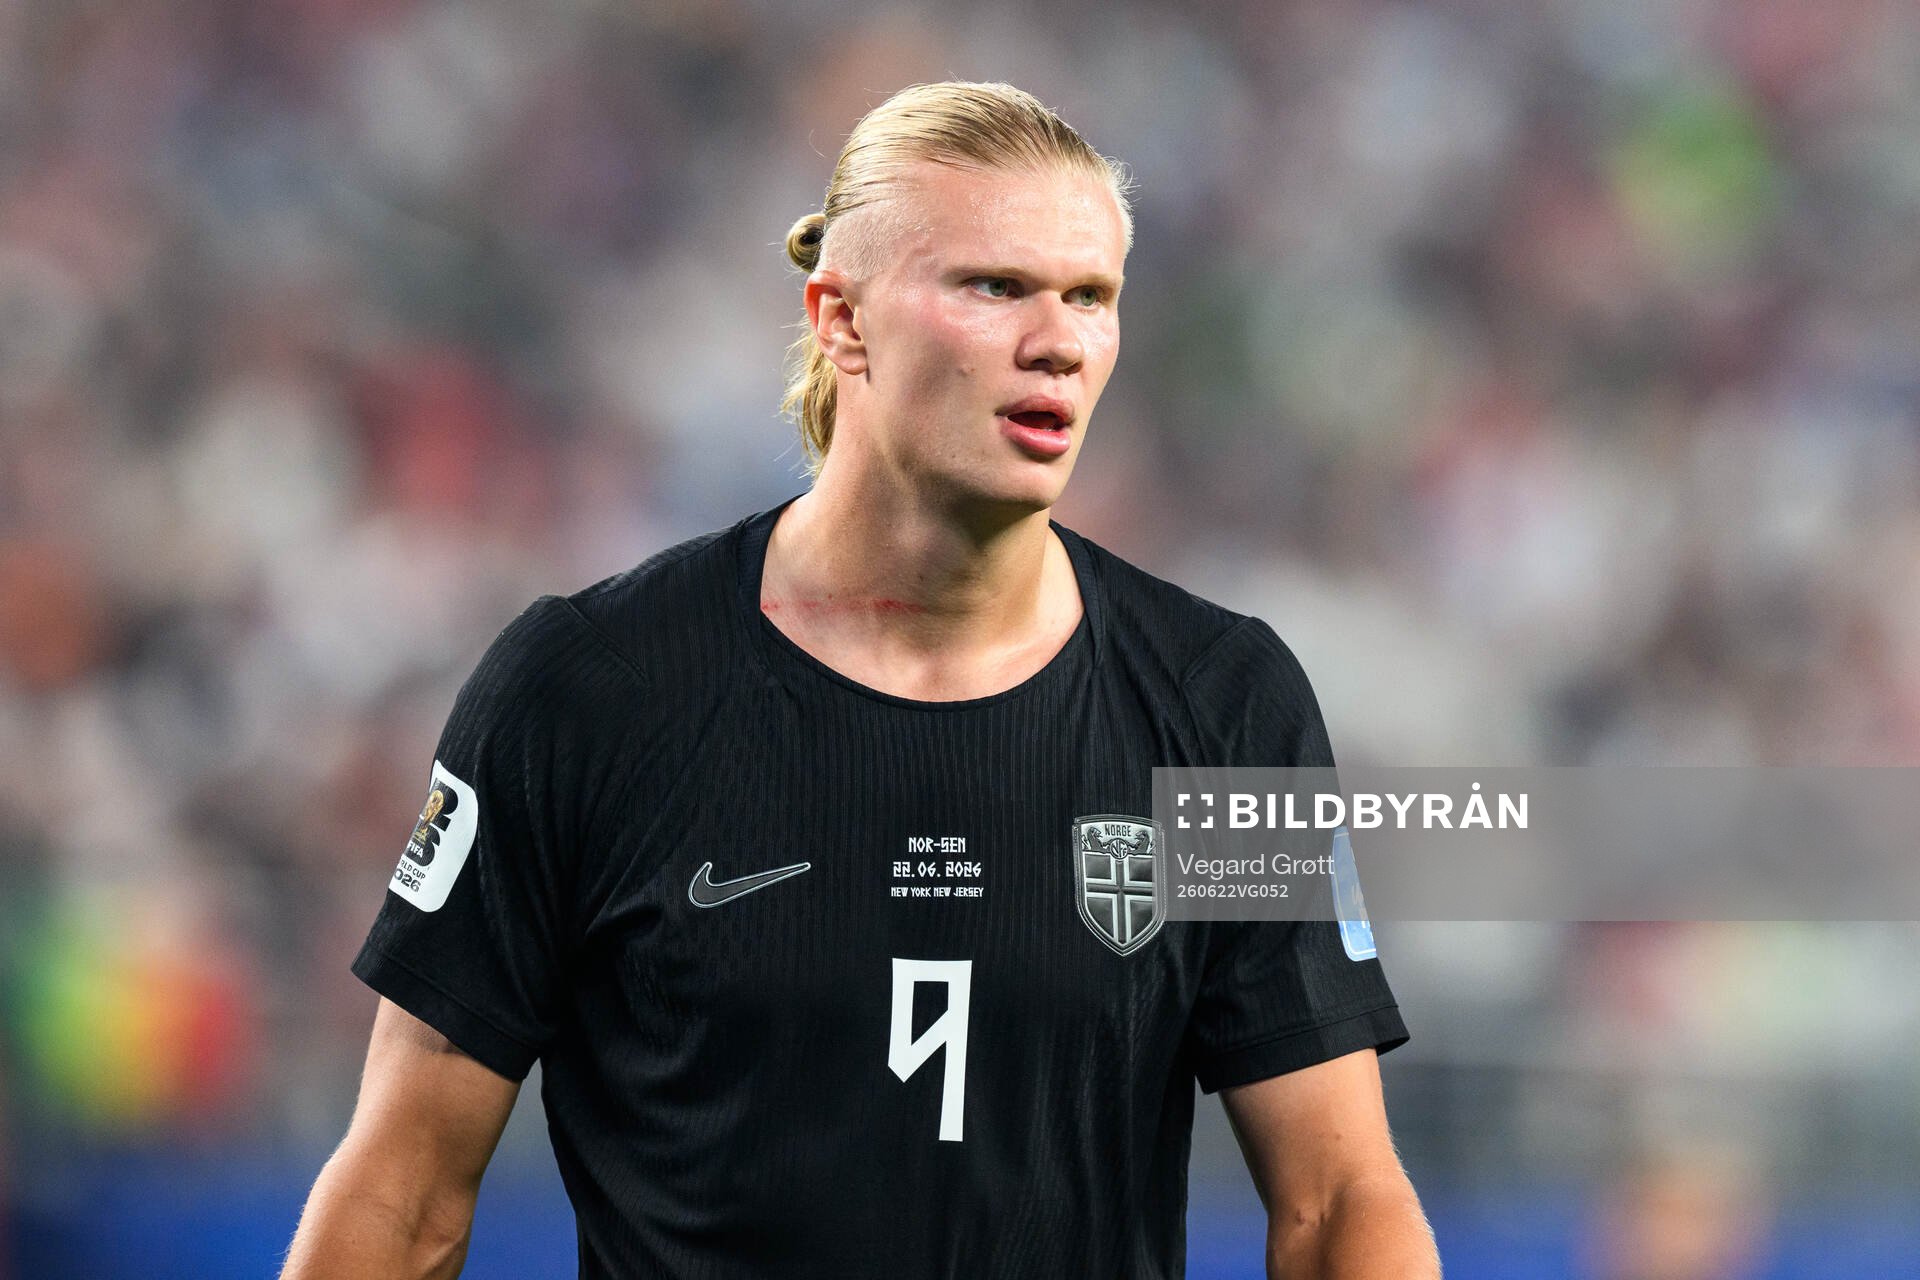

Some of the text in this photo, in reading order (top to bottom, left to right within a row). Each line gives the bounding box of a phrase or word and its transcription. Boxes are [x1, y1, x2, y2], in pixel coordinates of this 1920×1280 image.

[1105, 823, 1131, 837] NORGE
[407, 842, 424, 858] FIFA
[908, 836, 966, 853] NOR-SEN
[400, 859, 426, 880] RLD CUP
[395, 868, 421, 892] 026
[891, 886, 984, 898] NEW YORK NEW JERSEY
[887, 957, 973, 1142] 9
